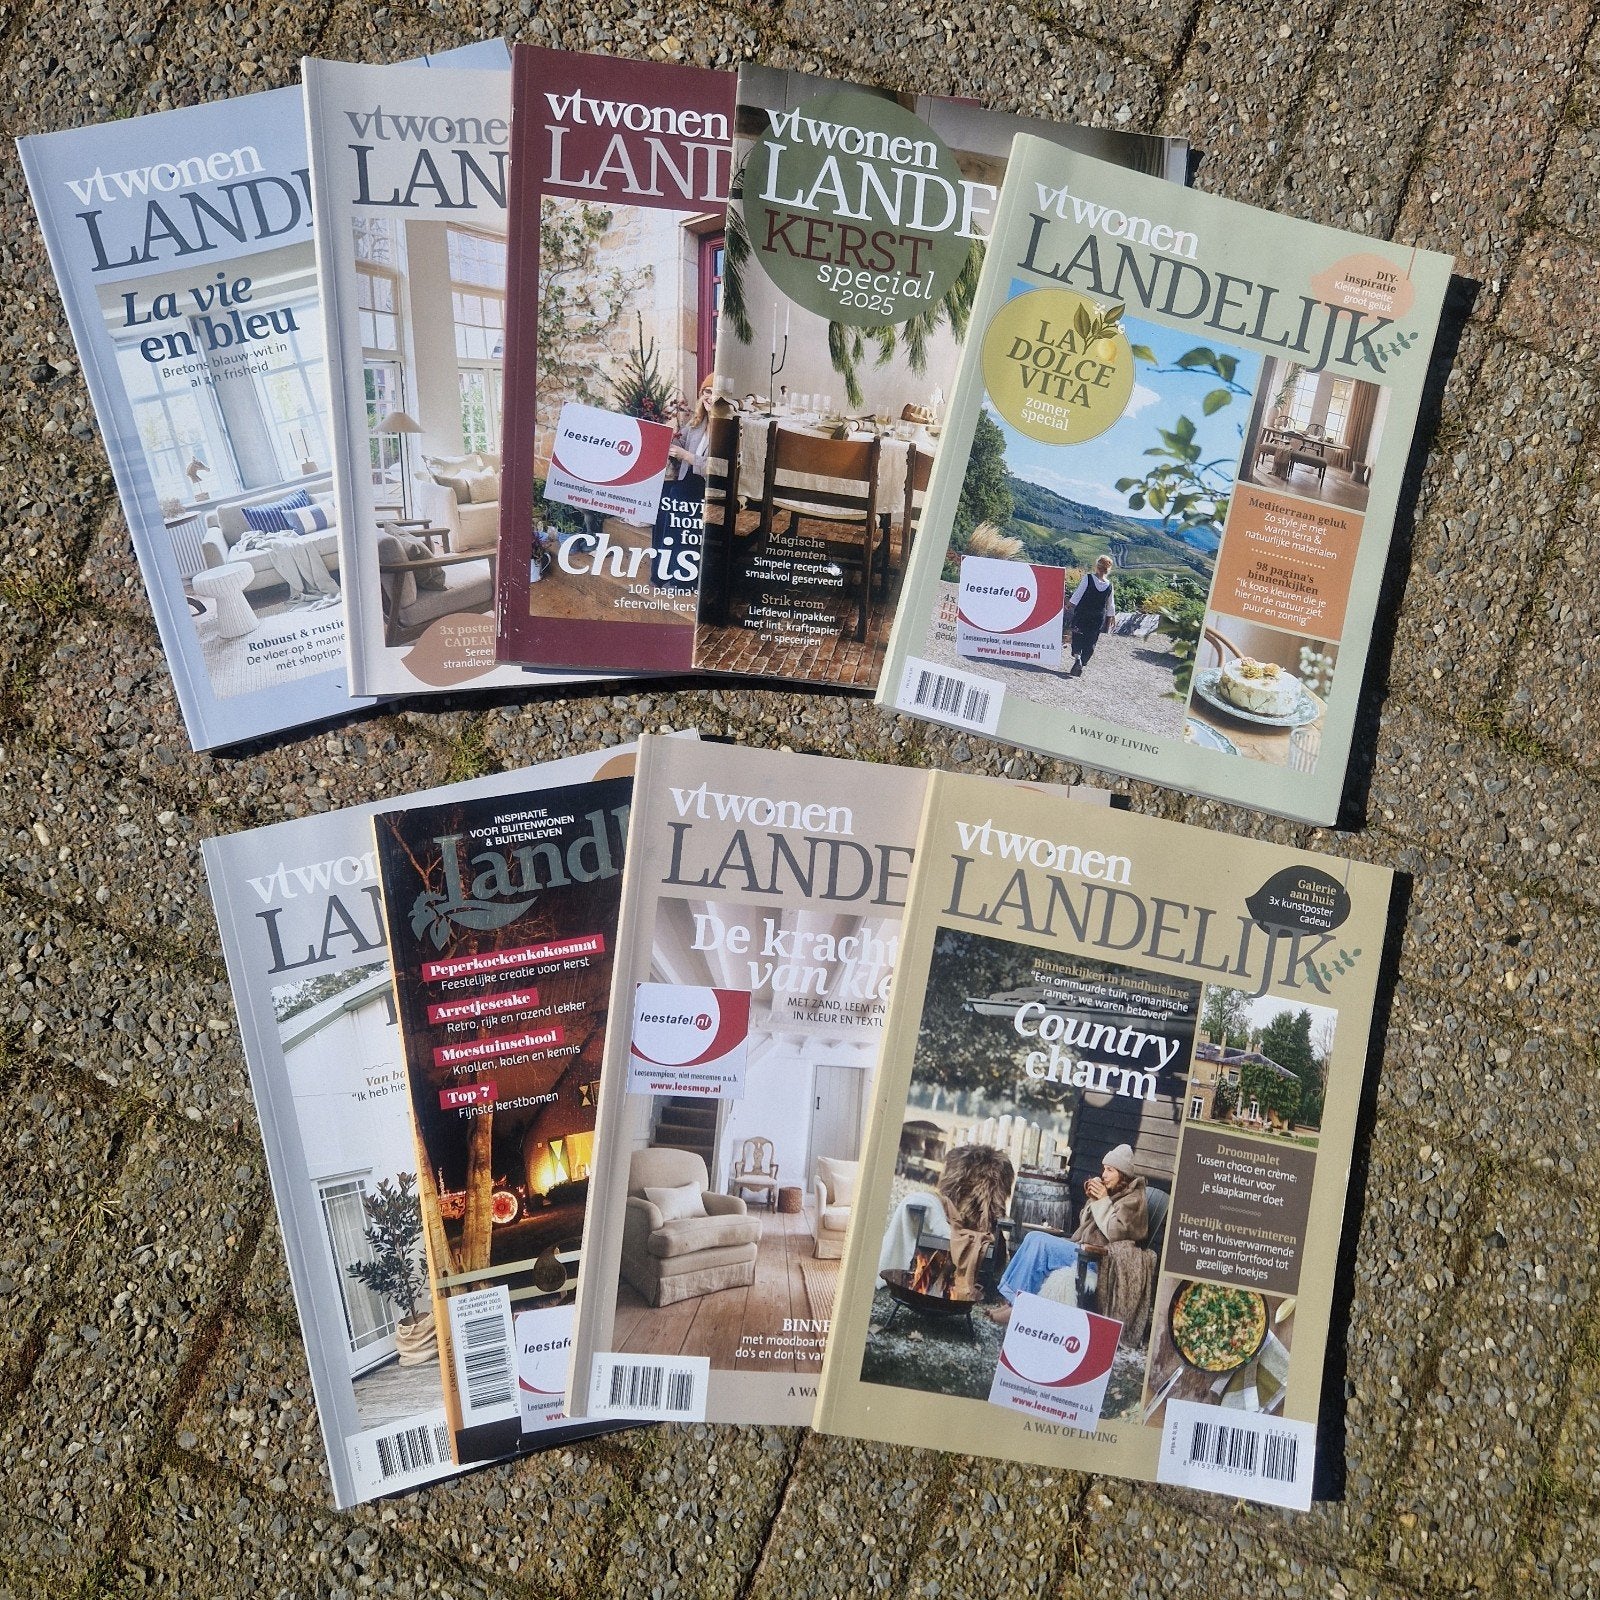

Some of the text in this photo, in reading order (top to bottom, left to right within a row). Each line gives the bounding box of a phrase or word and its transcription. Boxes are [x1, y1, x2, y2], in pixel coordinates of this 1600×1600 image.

[543, 88, 731, 141] vtwonen
[764, 107, 939, 170] vtwonen
[64, 145, 266, 205] vtwonen
[758, 140, 998, 242] LANDE
[1034, 182, 1199, 261] vtwonen
[761, 208, 933, 279] KERST
[816, 264, 935, 301] special
[1017, 212, 1394, 374] LANDELIJK
[1344, 272, 1397, 294] inspiratie
[122, 272, 253, 328] La vie
[839, 290, 896, 316] 2025
[1343, 294, 1392, 313] groot geluk
[140, 306, 300, 364] en bleu
[1035, 319, 1078, 354] LA
[162, 344, 274, 379] Bretons blauw-wit
[224, 361, 269, 380] frisheid
[1006, 336, 1116, 389] DOLCE
[1019, 363, 1091, 409] VITA
[1025, 397, 1071, 418] zomer
[1020, 408, 1069, 432] special
[563, 428, 631, 453] leestafel.nl
[567, 493, 637, 516] www.leesmap.nl
[1248, 497, 1348, 530] Mediterraan geluk
[768, 532, 826, 549] Magische
[1264, 524, 1290, 537] warm
[1308, 524, 1328, 536] met
[765, 547, 828, 561] momenten
[1245, 529, 1338, 560] natuurlijke materialen
[557, 532, 701, 582] Chris
[753, 556, 791, 570] Simpele
[745, 568, 843, 587] smaakvol geserveerd
[1247, 569, 1319, 595] binnenkijken
[1269, 565, 1314, 584] pagina's
[628, 583, 650, 595] 106
[965, 582, 1029, 600] leestafel.nl
[1270, 585, 1302, 602] kleuren
[613, 597, 670, 611] sfeervolle
[761, 593, 825, 610] Strik erom
[1234, 588, 1304, 614] hier natuur
[1242, 601, 1264, 614] puur
[744, 618, 764, 629] met
[748, 605, 836, 623] Liefdevol inpakken
[248, 632, 298, 652] Robuust
[760, 632, 821, 648] en specerijen
[263, 648, 289, 661] vloer
[299, 647, 342, 666] shoptips
[977, 646, 1041, 660] www.leesmap.nl
[1079, 726, 1160, 756] WAY OF LIVING
[494, 808, 549, 825] INSPIRATIE
[668, 781, 854, 835] vtwonen
[469, 814, 576, 840] VOOR BUITENWONEN
[495, 827, 563, 847] BUITENLEVEN
[954, 818, 1132, 886] vtwonen
[661, 821, 916, 908] LANDE
[1289, 890, 1335, 907] aan huis
[1297, 879, 1337, 896] Galerie
[1268, 895, 1334, 918] 3x kunstposter
[942, 853, 1337, 999] LANDELIJK
[1299, 914, 1331, 928] cadeau
[690, 913, 751, 954] De
[429, 938, 598, 977] Peperkoekenkokosmat
[441, 956, 591, 991] Feestelijke creatie kerst
[747, 961, 829, 996] van
[1033, 957, 1190, 999] Binnenkijken in landhuisluxe
[787, 996, 872, 1014] MET ZAND, LEEM
[1053, 976, 1189, 1013] ommuurde tuin, romantische
[1078, 996, 1125, 1013] we waren
[434, 993, 531, 1020] Arretjescake
[515, 1000, 588, 1022] razend lekker
[792, 1010, 853, 1024] IN KLEUR EN
[640, 1011, 710, 1027] leestafel.nl
[441, 1029, 558, 1062] Moestuinschool
[1013, 1001, 1180, 1073] Country
[499, 1044, 582, 1068] kolen en kennis
[1025, 1043, 1158, 1103] charm
[368, 1086, 389, 1099] heb
[447, 1086, 490, 1105] Top 7
[650, 1081, 721, 1095] www.leesmap.nl
[457, 1092, 560, 1121] Fijnste kerstbomen
[1196, 1153, 1266, 1176] Tussen choco en
[1216, 1143, 1281, 1167] Droompalet
[1213, 1172, 1277, 1192] wat kleur voor
[1211, 1184, 1285, 1207] slaapkamer doet
[1179, 1212, 1297, 1245] Heerlijk overwinteren
[1202, 1232, 1295, 1258] en huisverwarmende
[1195, 1258, 1269, 1280] gezellige hoekjes
[1200, 1246, 1289, 1270] van comfortfood tot
[742, 1334, 764, 1345] met
[1014, 1322, 1078, 1350] leestafel.nl
[735, 1346, 806, 1361] do's en don'ts
[787, 1386, 796, 1397] A
[1012, 1395, 1078, 1421] www.leesmap.nl
[1023, 1421, 1118, 1444] A WAY OF LIVING
